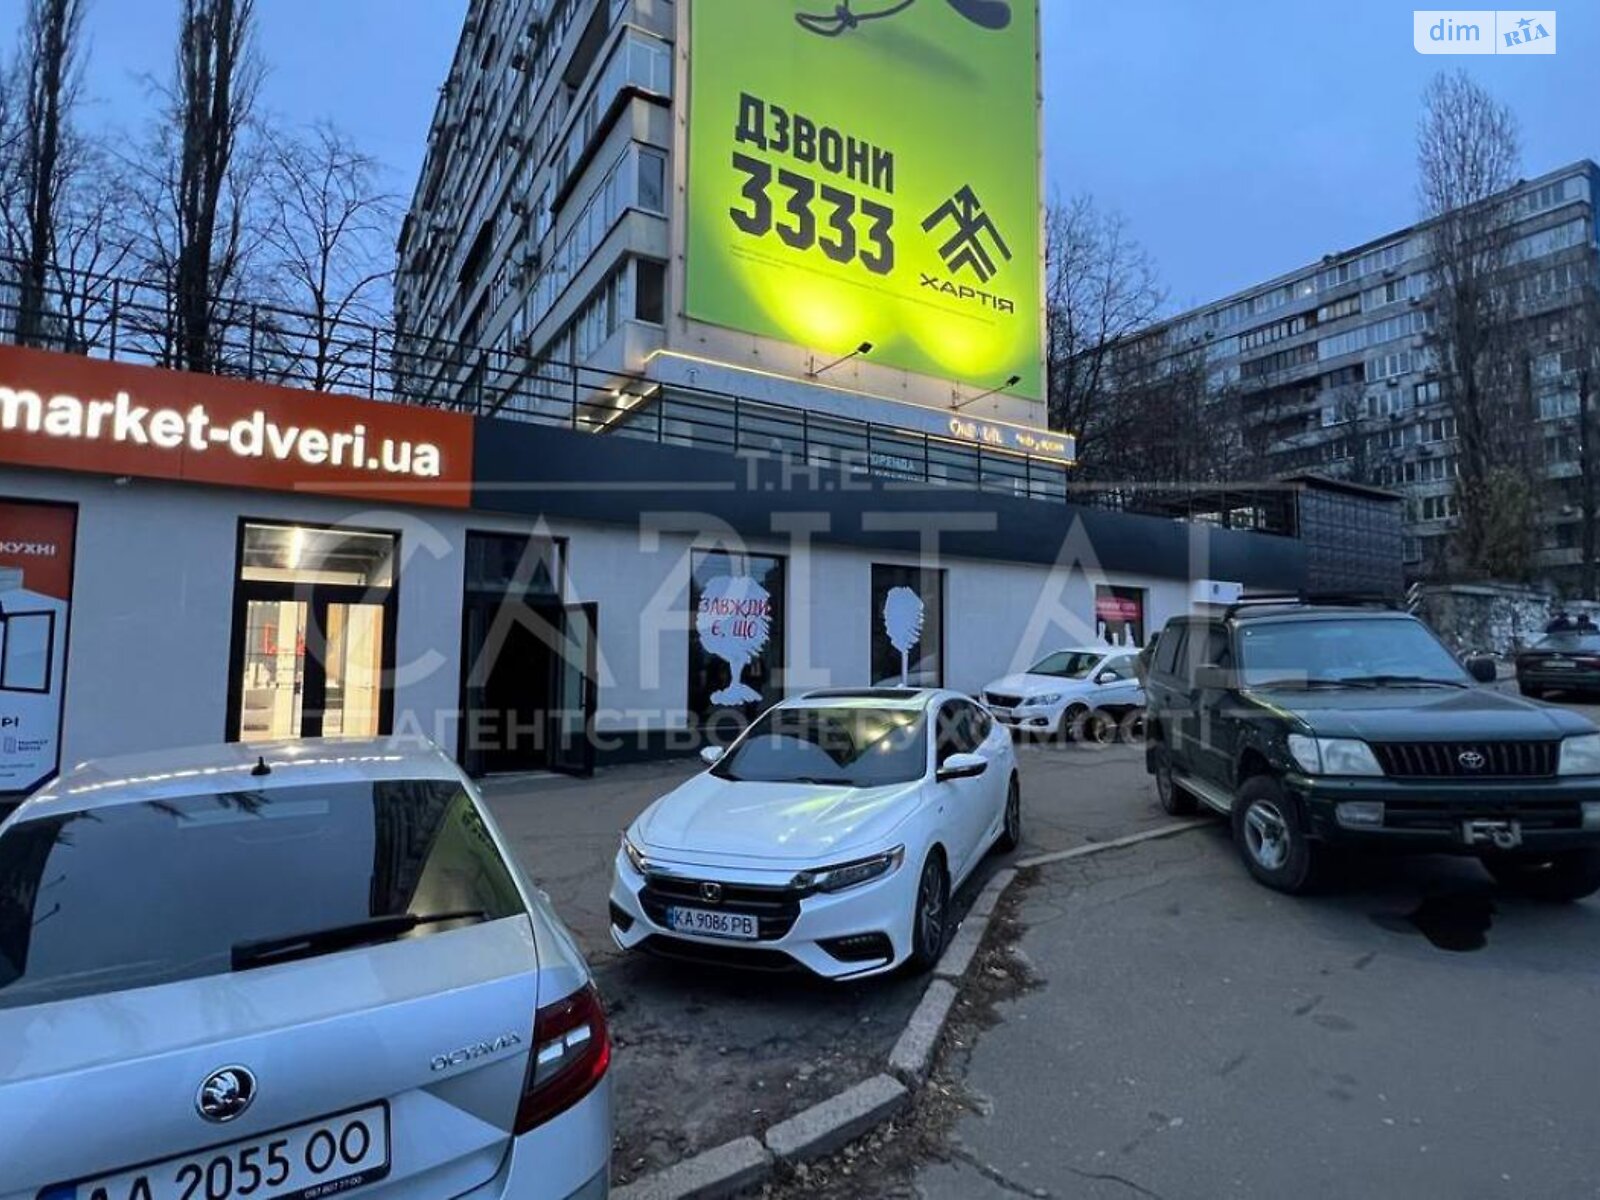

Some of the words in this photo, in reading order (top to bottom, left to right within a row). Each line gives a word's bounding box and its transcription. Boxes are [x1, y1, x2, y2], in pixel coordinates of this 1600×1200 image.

[735, 92, 894, 194] ДЗВОНИ
[729, 151, 895, 276] 3333
[920, 272, 1015, 314] ХАРТІЯ
[0, 386, 441, 477] market-dveri.ua
[700, 598, 769, 617] ЗАВЖДИ
[732, 620, 758, 640] ЩО
[696, 912, 729, 932] 9086
[731, 916, 753, 934] PB
[175, 1139, 289, 1200] 2055
